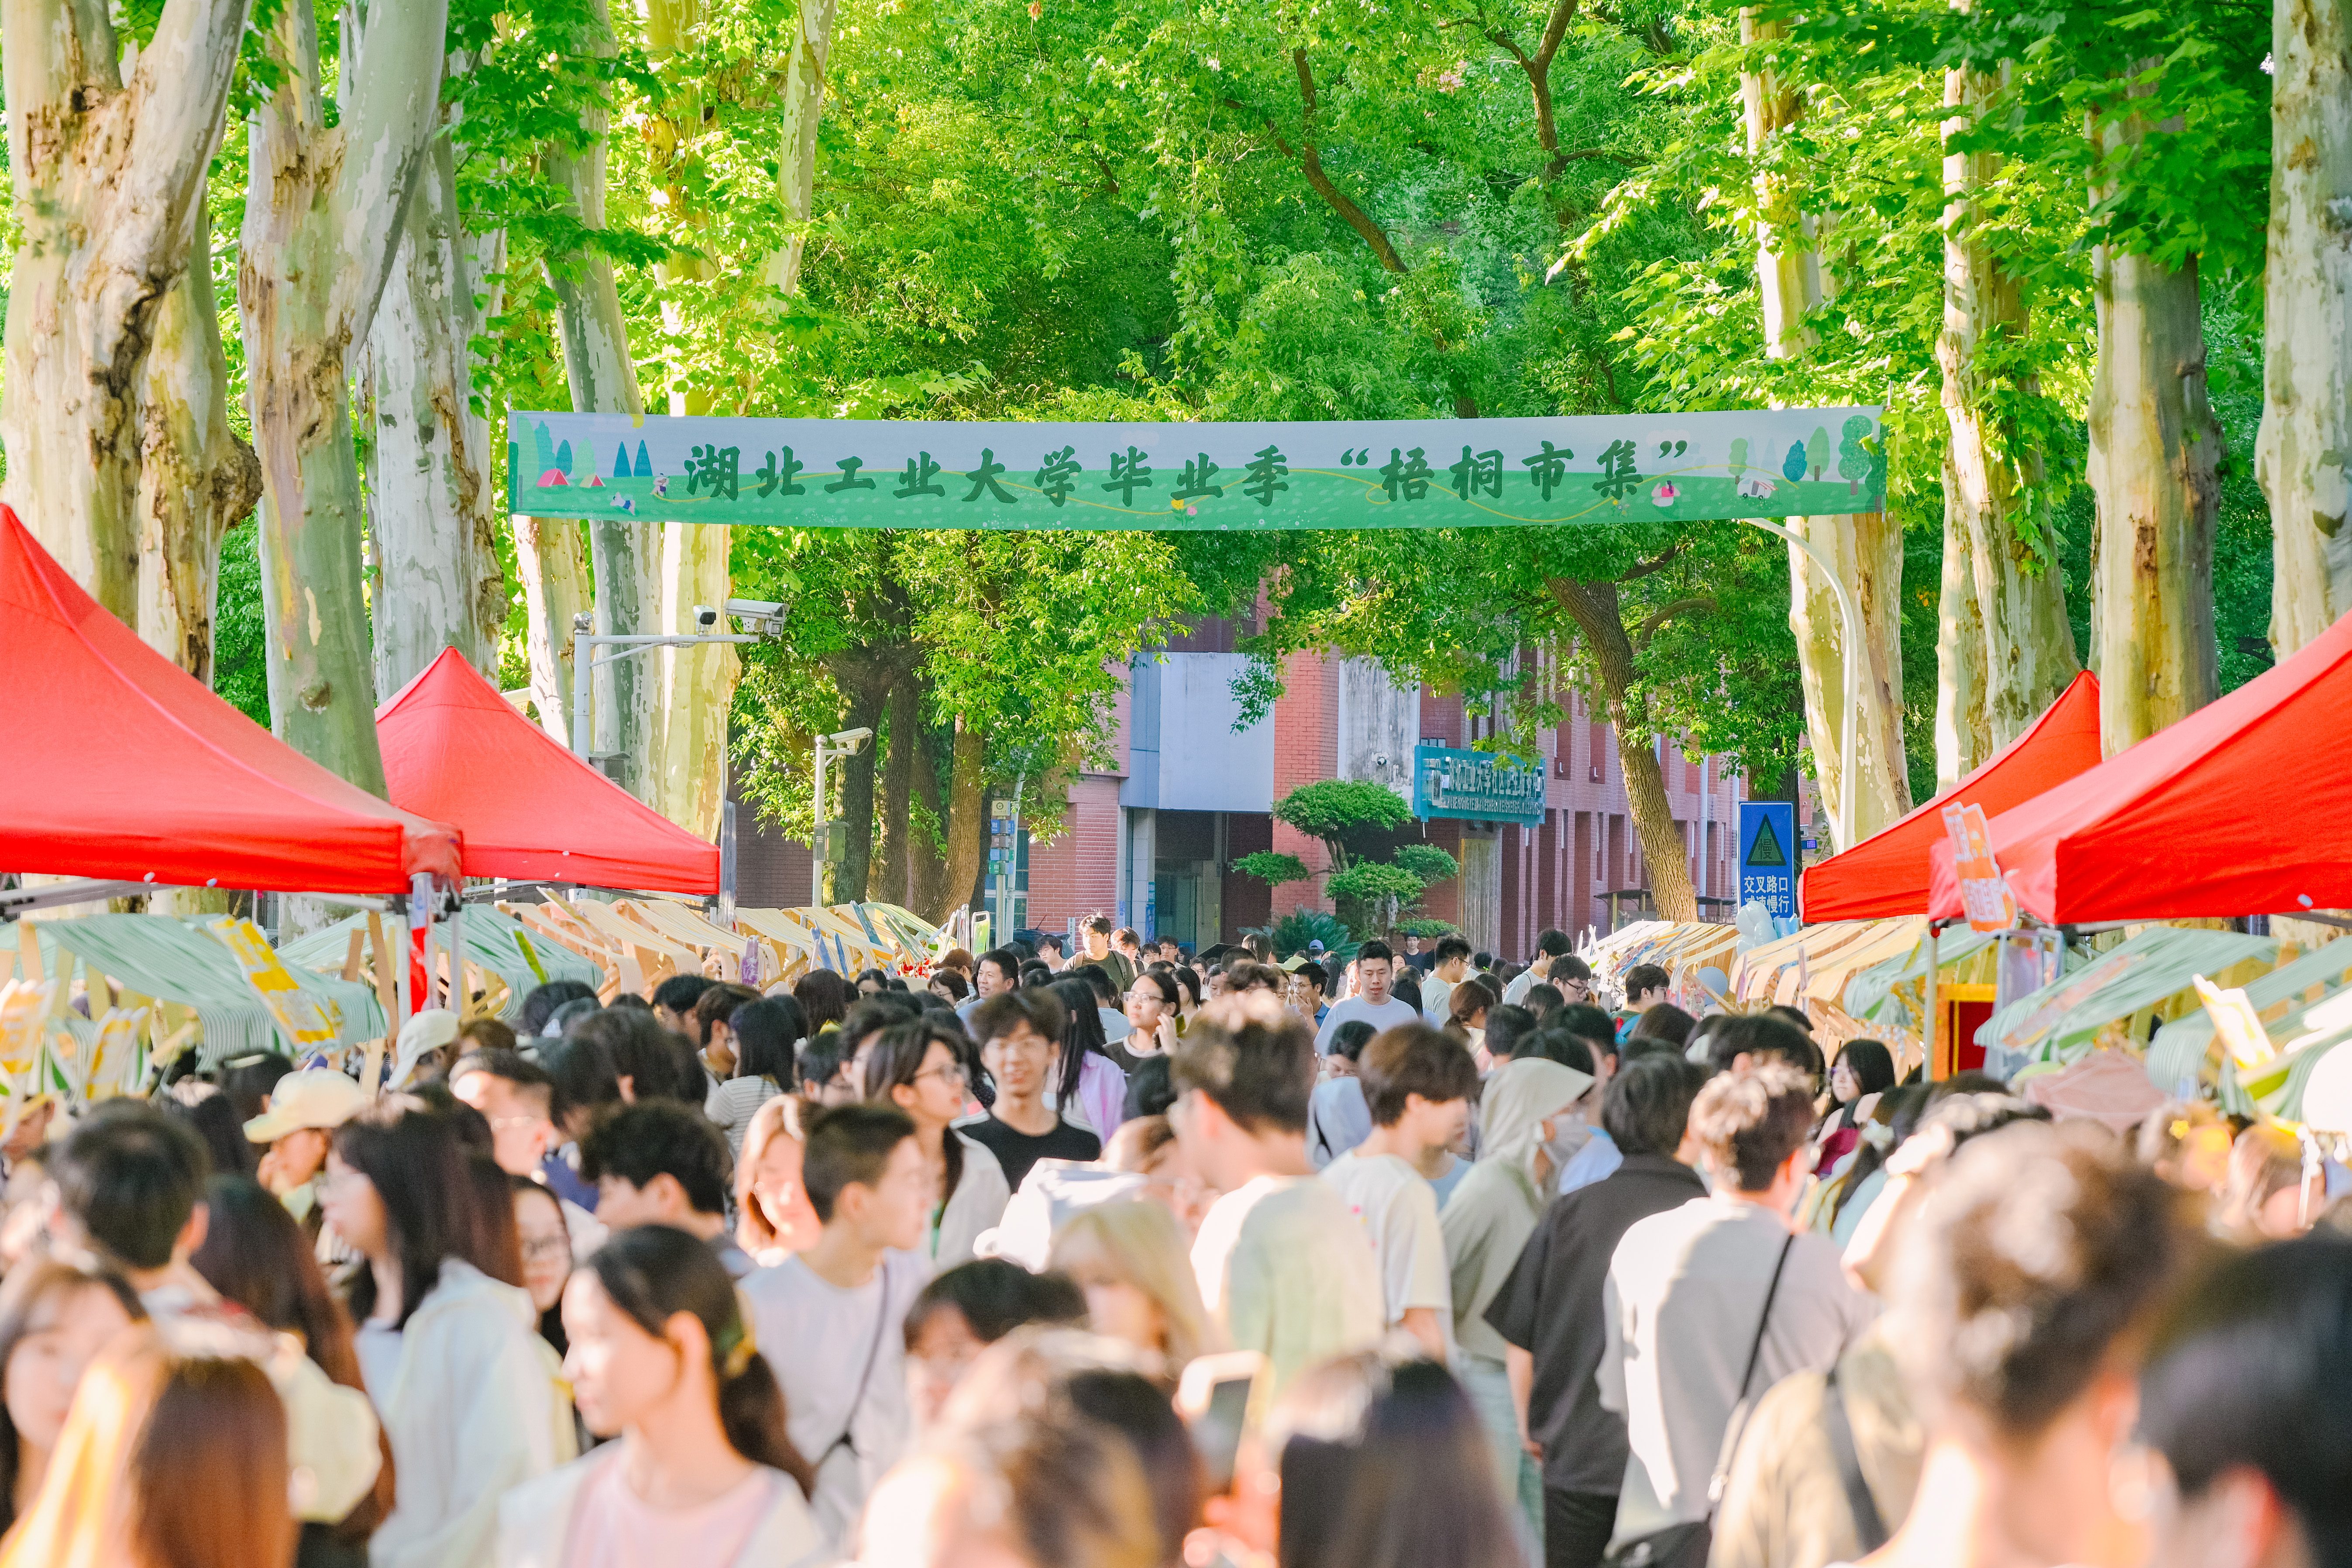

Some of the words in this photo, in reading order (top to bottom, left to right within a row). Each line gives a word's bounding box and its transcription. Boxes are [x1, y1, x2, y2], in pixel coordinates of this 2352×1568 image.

[1759, 838, 1772, 860] 慢
[1744, 875, 1788, 894] 交叉路口
